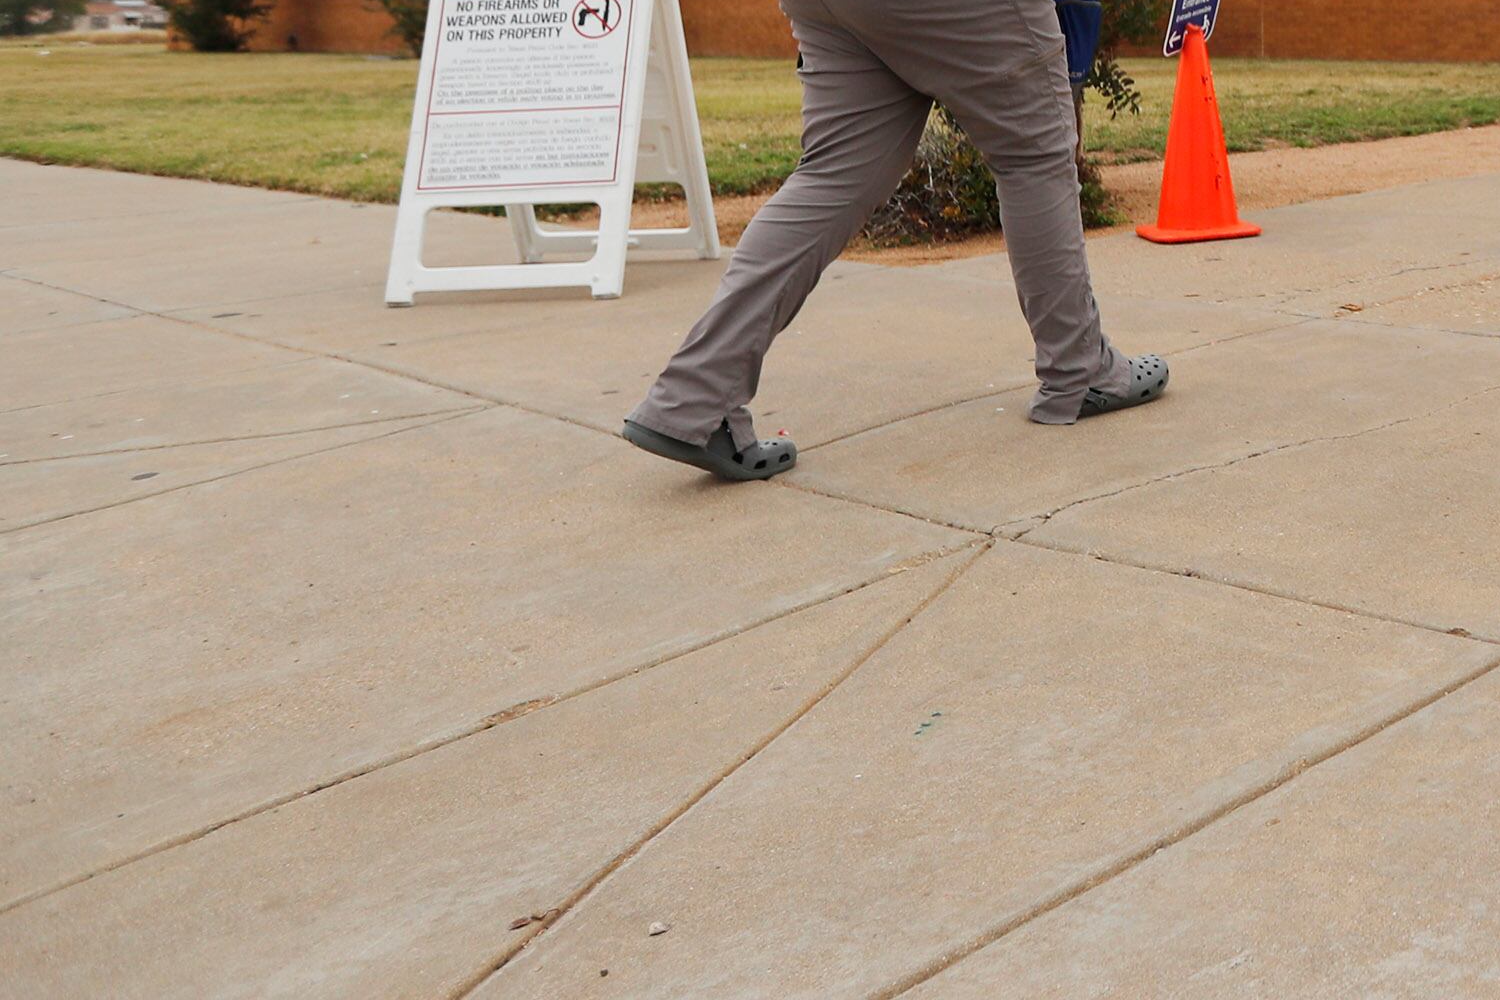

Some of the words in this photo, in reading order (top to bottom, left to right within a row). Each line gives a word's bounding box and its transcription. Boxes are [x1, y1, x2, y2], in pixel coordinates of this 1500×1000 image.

[456, 1, 473, 12] NO
[446, 14, 506, 27] WEAPONS
[510, 12, 568, 25] ALLOWED
[446, 30, 464, 42] ON
[468, 28, 495, 41] THIS
[499, 26, 563, 39] PROPERTY
